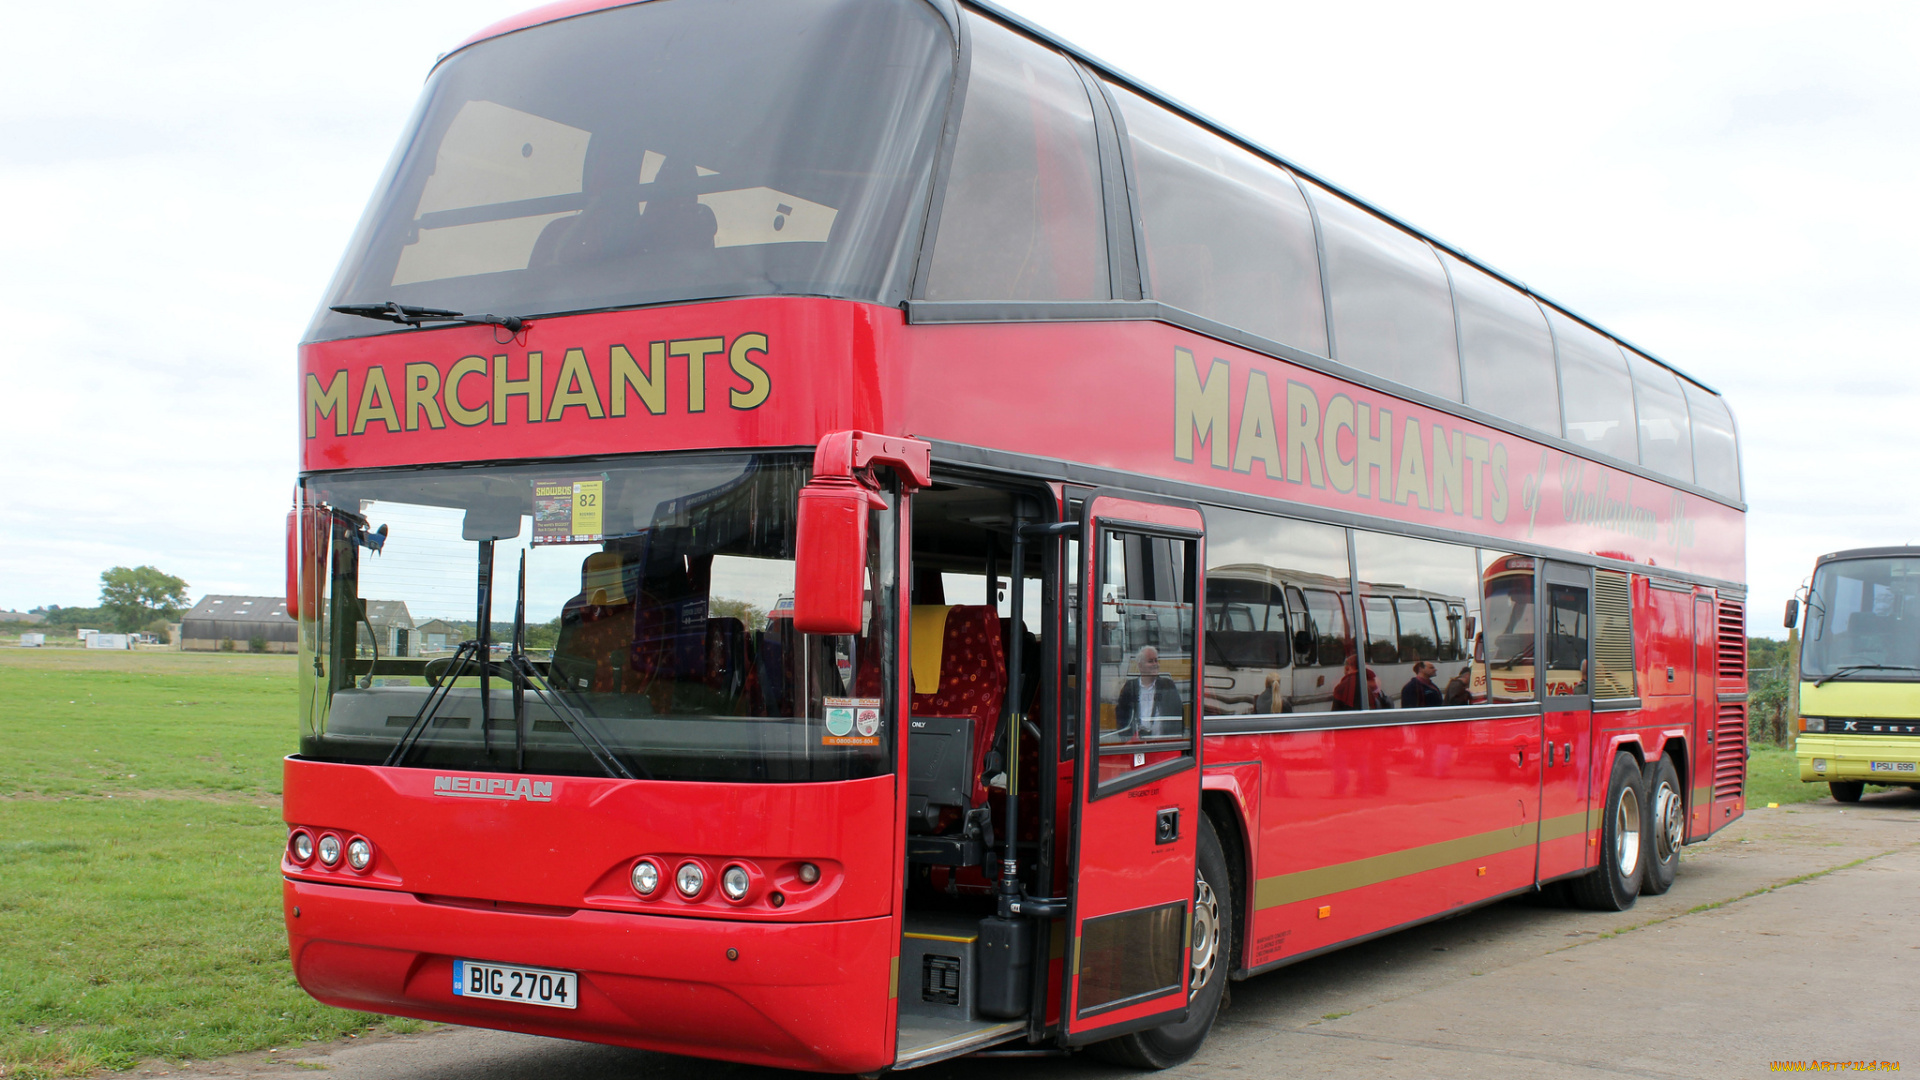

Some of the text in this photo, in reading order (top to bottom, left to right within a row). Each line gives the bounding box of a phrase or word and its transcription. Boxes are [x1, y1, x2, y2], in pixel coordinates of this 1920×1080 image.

[305, 332, 771, 439] MARCHANTS
[1174, 345, 1509, 524] MARCHANTS
[1522, 450, 1547, 538] of
[1560, 454, 1658, 541] Cheltenham
[536, 486, 572, 496] SHOWBUS
[579, 493, 596, 507] 82
[911, 721, 926, 729] ONLY
[1876, 762, 1914, 771] PSU 699
[434, 776, 553, 802] NEOPLAN
[470, 966, 568, 1003] BIG 2704
